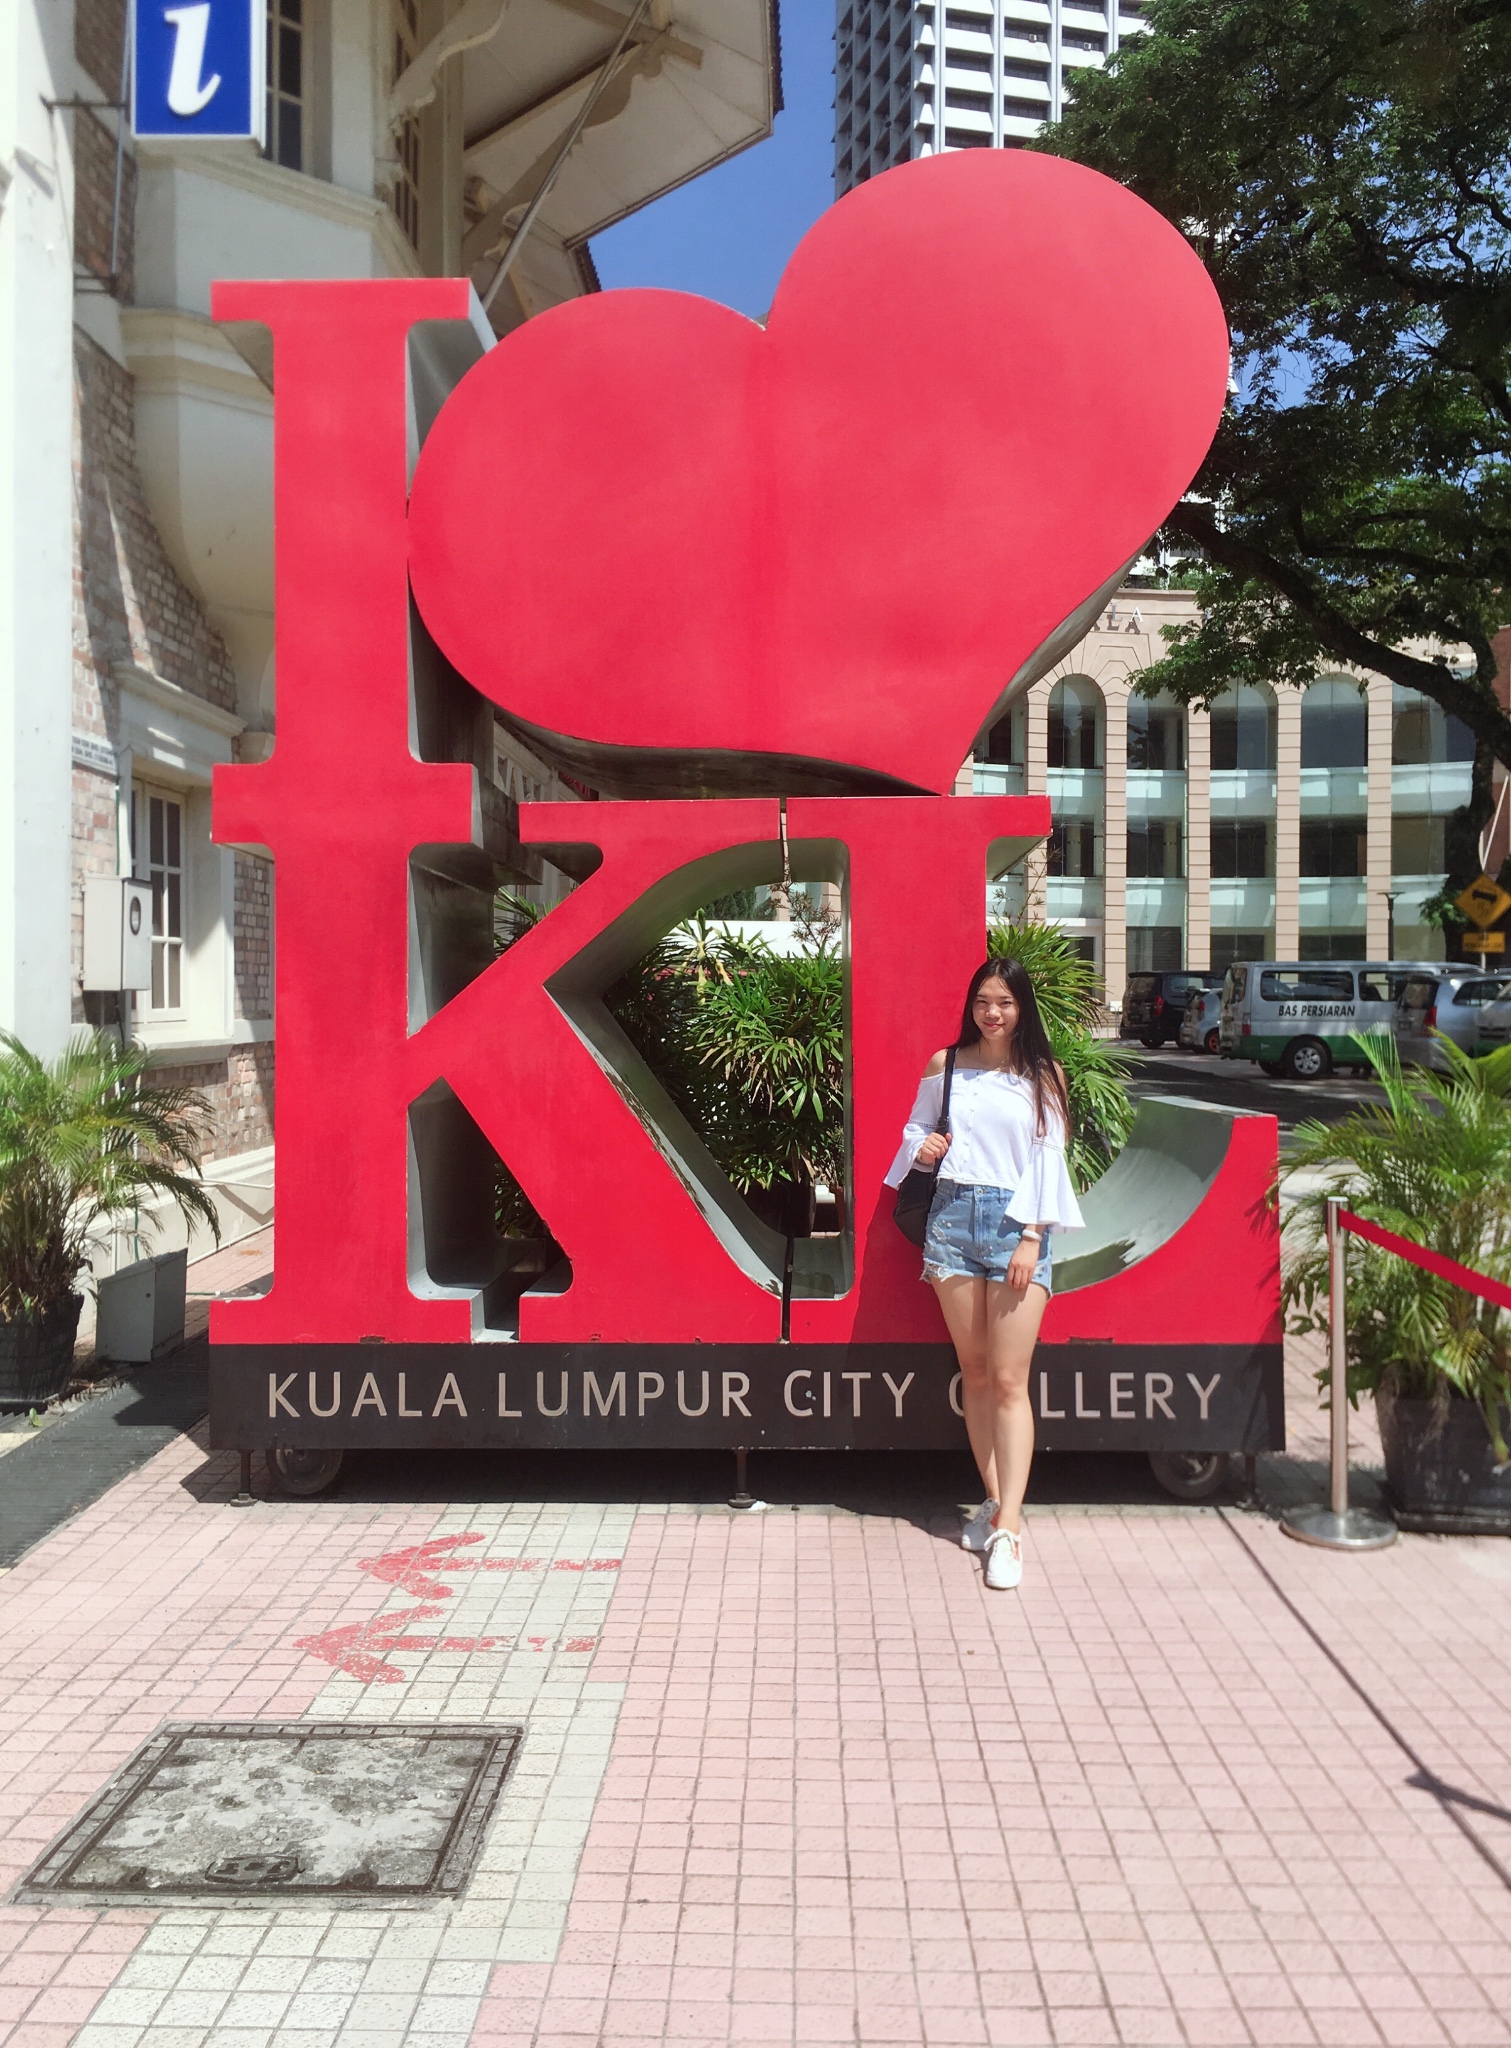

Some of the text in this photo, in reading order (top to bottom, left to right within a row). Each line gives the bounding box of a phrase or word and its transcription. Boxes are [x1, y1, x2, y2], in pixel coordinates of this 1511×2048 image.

[1278, 1004, 1355, 1017] BAS PERSIARAN
[267, 1368, 1222, 1420] KUALA LUMPUR CITY LLERY
